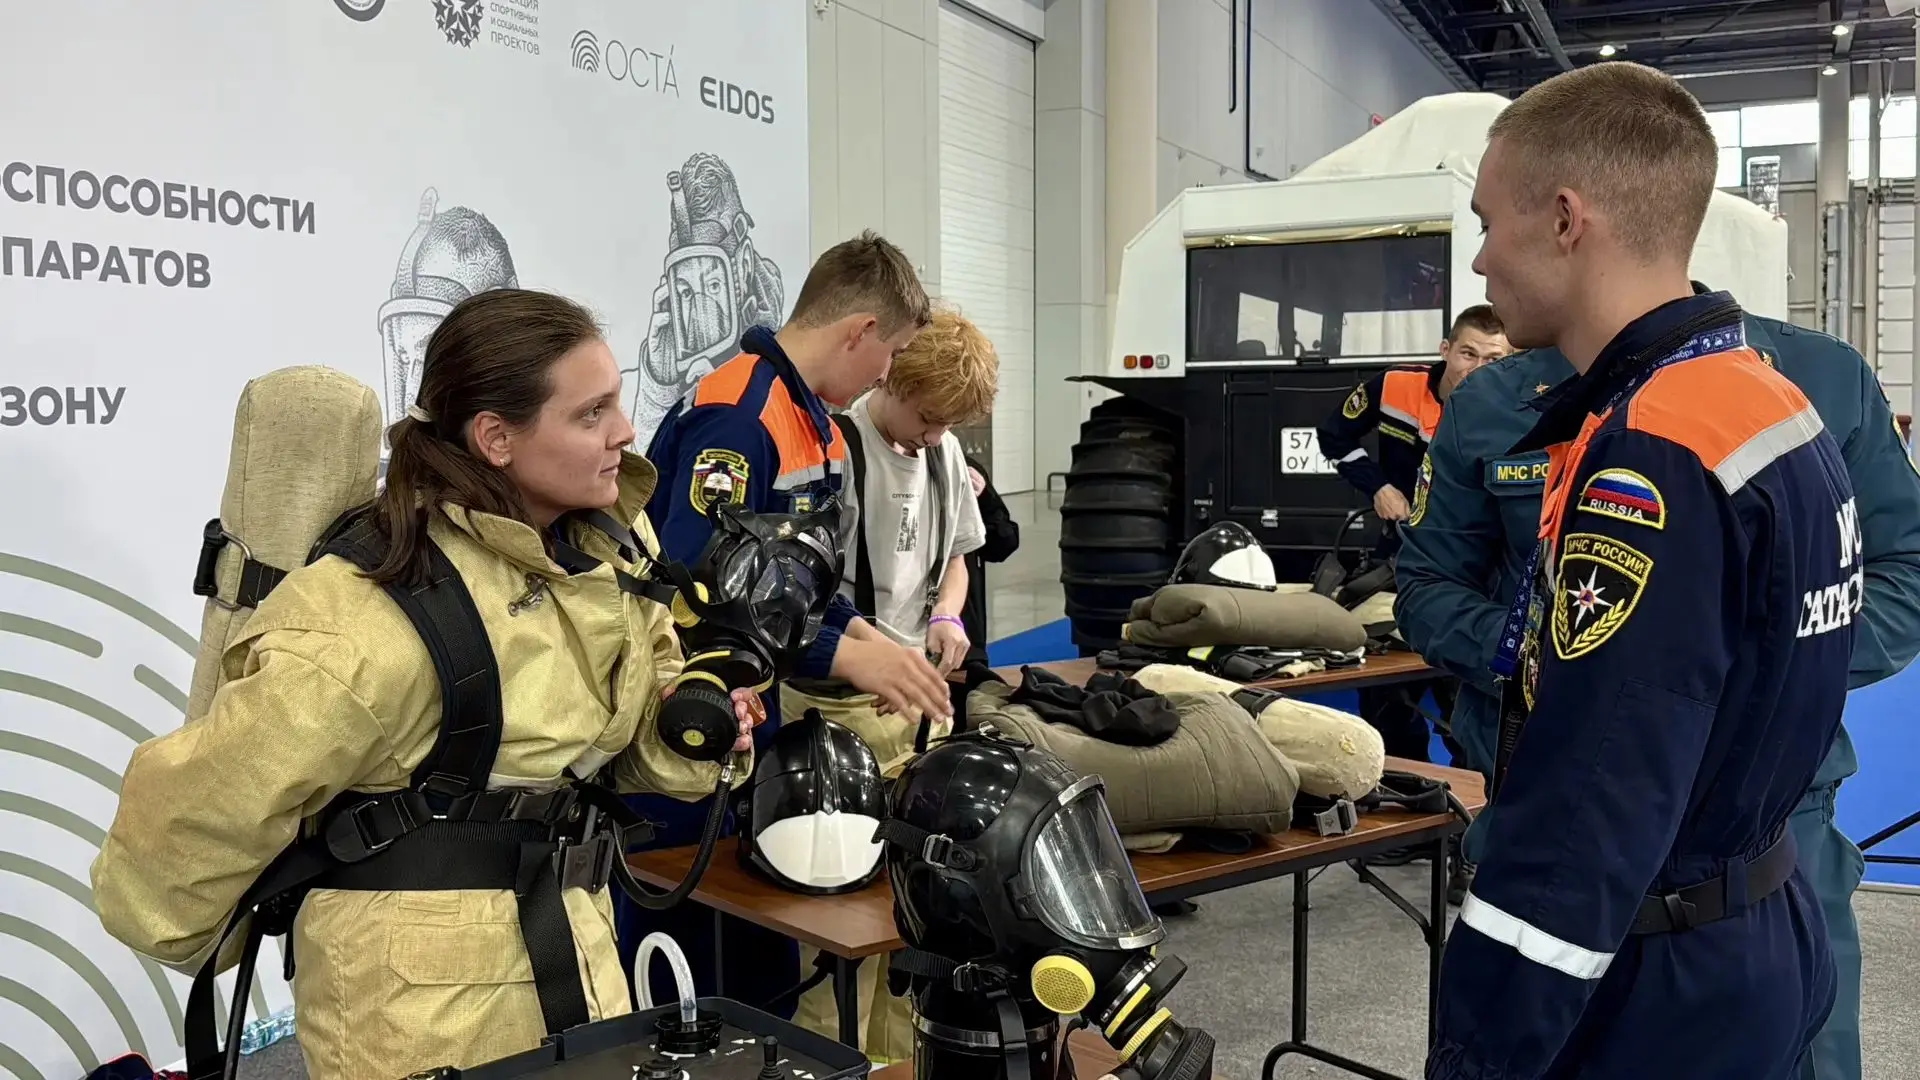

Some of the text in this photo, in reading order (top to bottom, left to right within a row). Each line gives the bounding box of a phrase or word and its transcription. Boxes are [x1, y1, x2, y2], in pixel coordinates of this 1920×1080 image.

[491, 31, 540, 55] ПРОЕКТОВ
[700, 76, 774, 124] EIDOS
[0, 161, 316, 234] СПОСОБНОСТИ
[2, 236, 211, 288] ПАРАТОВ
[0, 386, 126, 426] ЗОНУ
[1290, 432, 1313, 449] 57
[1497, 465, 1528, 481] МЧС
[1590, 498, 1645, 521] RUSSIA
[1569, 539, 1645, 575] МЧС РОССИИ
